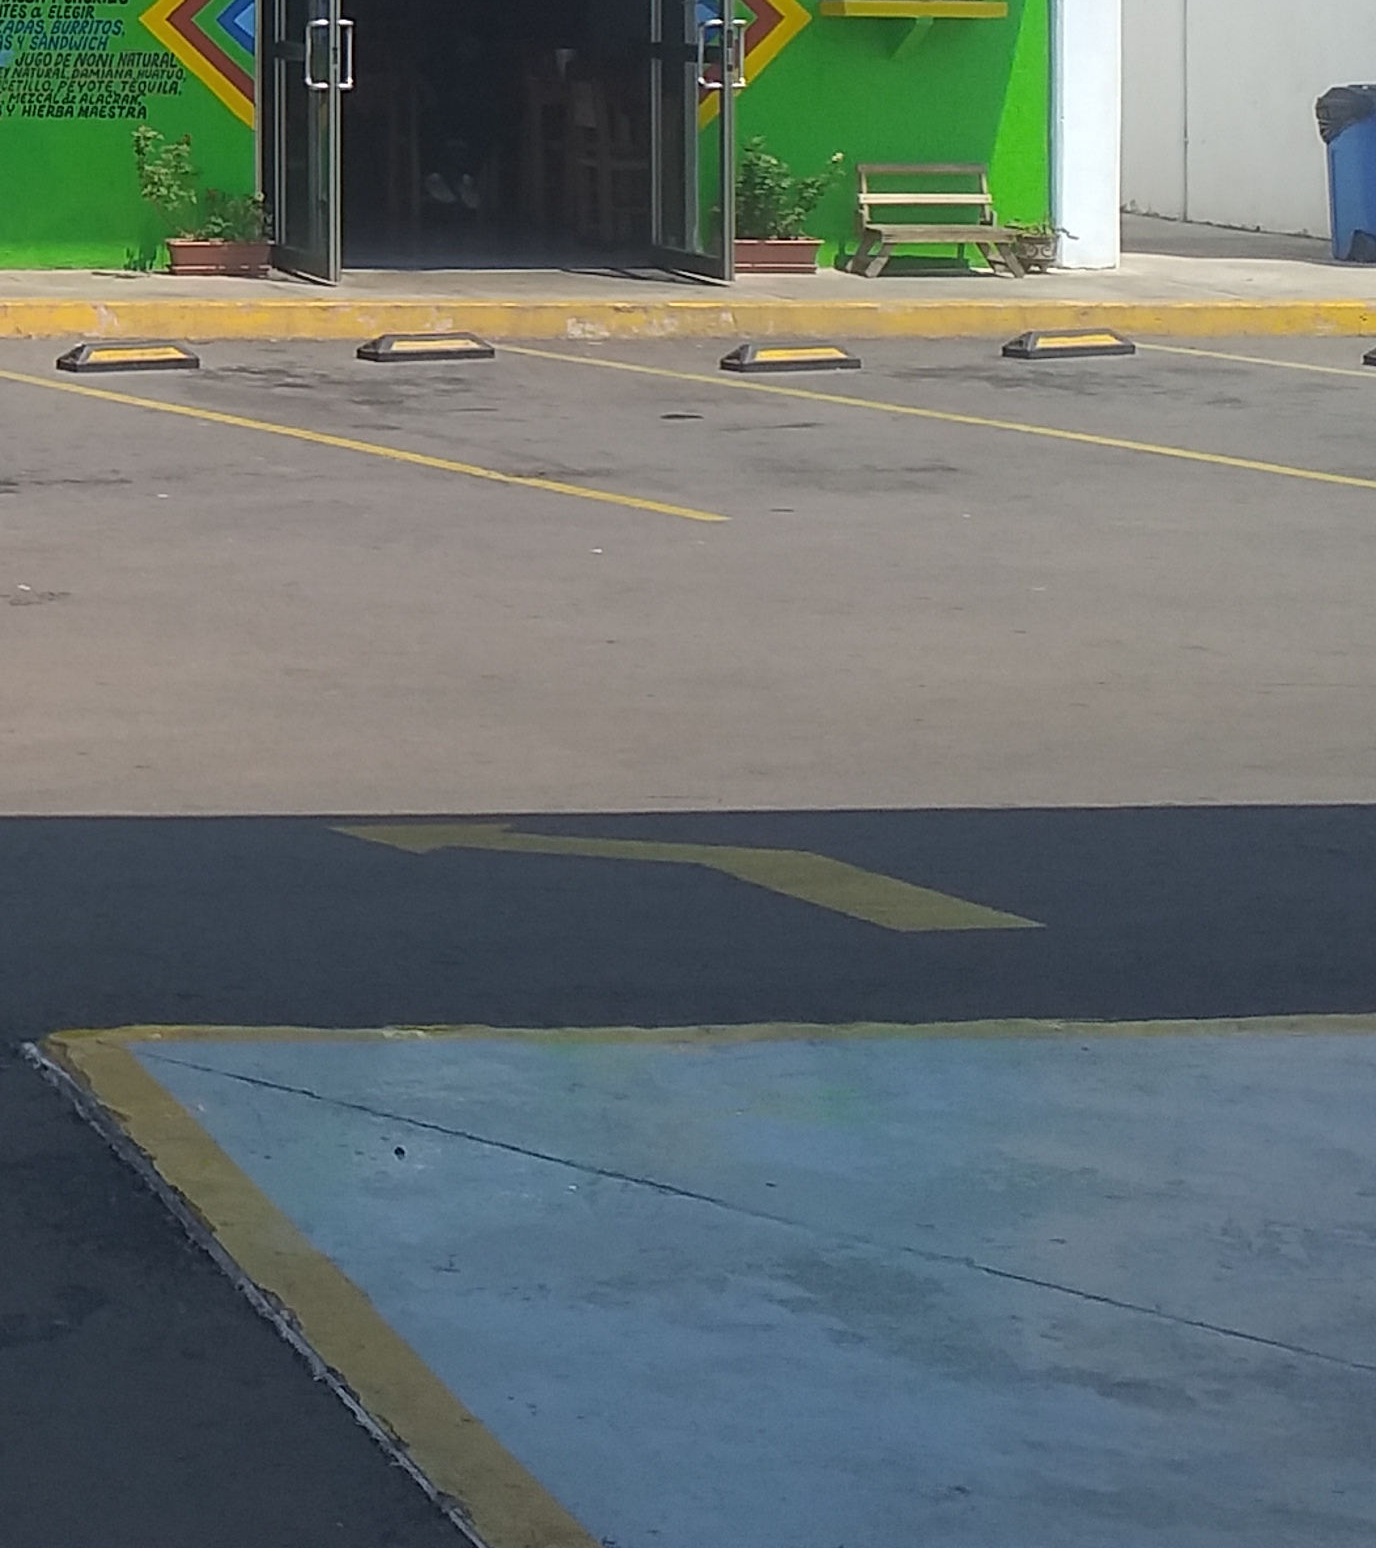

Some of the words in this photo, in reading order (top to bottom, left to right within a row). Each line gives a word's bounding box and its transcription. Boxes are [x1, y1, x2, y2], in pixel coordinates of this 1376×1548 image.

[48, 4, 95, 19] ELEGIR
[29, 35, 110, 52] SANDWICH
[14, 52, 53, 67] JUGO
[54, 52, 72, 67] DE
[73, 52, 115, 68] NONI
[117, 52, 178, 68] NATURAL
[8, 92, 60, 105] MEZCAL
[6, 103, 17, 117] Y
[21, 105, 75, 119] HIERBA
[77, 105, 147, 120] MAESTRA
